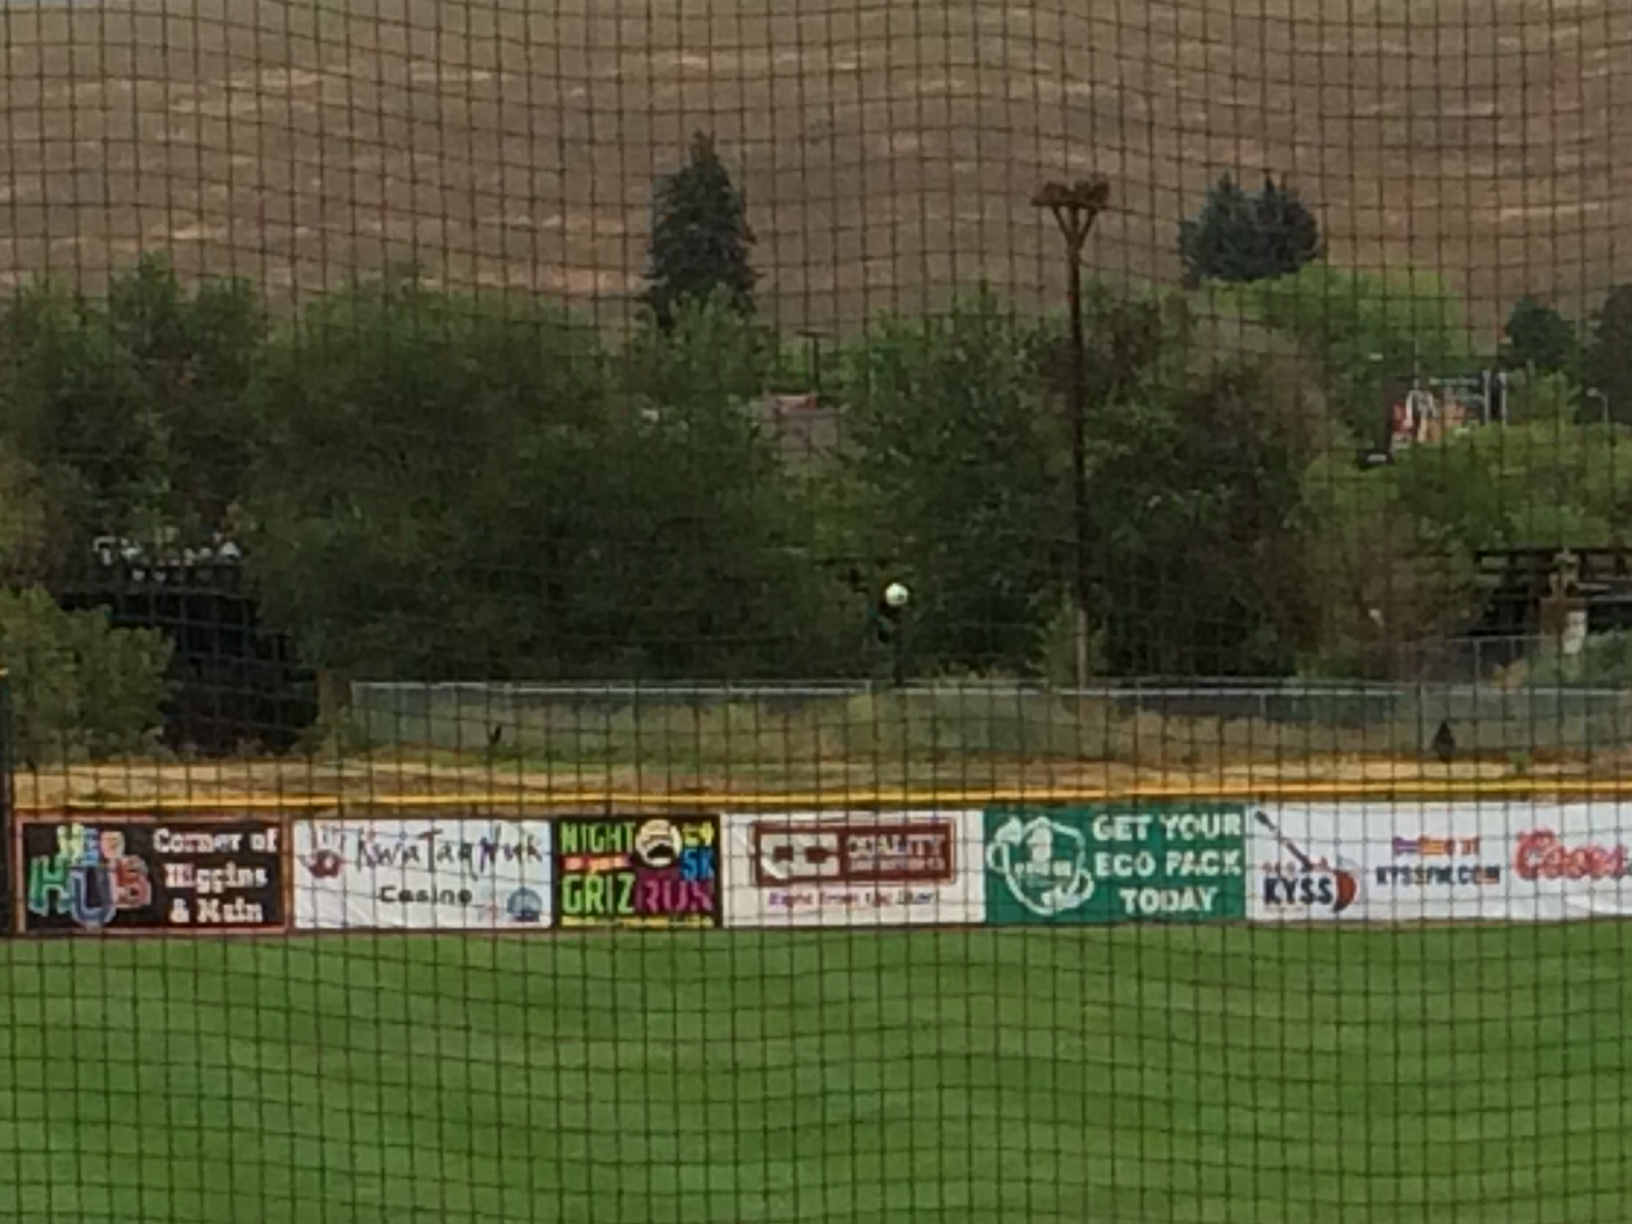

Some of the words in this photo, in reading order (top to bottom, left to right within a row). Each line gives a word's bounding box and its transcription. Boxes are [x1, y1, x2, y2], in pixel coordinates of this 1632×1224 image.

[153, 827, 244, 854] Corner
[561, 822, 636, 854] NIGHT
[1093, 814, 1152, 841] GET
[1160, 813, 1241, 841] YOUR
[1095, 851, 1156, 877] ECO
[1166, 850, 1242, 877] PACK
[1513, 828, 1628, 881] Coors
[28, 854, 152, 928] HUB
[561, 873, 636, 914] GRIZ
[1120, 886, 1218, 915] TODAY
[1264, 877, 1335, 906] KYSS
[197, 897, 264, 924] Main
